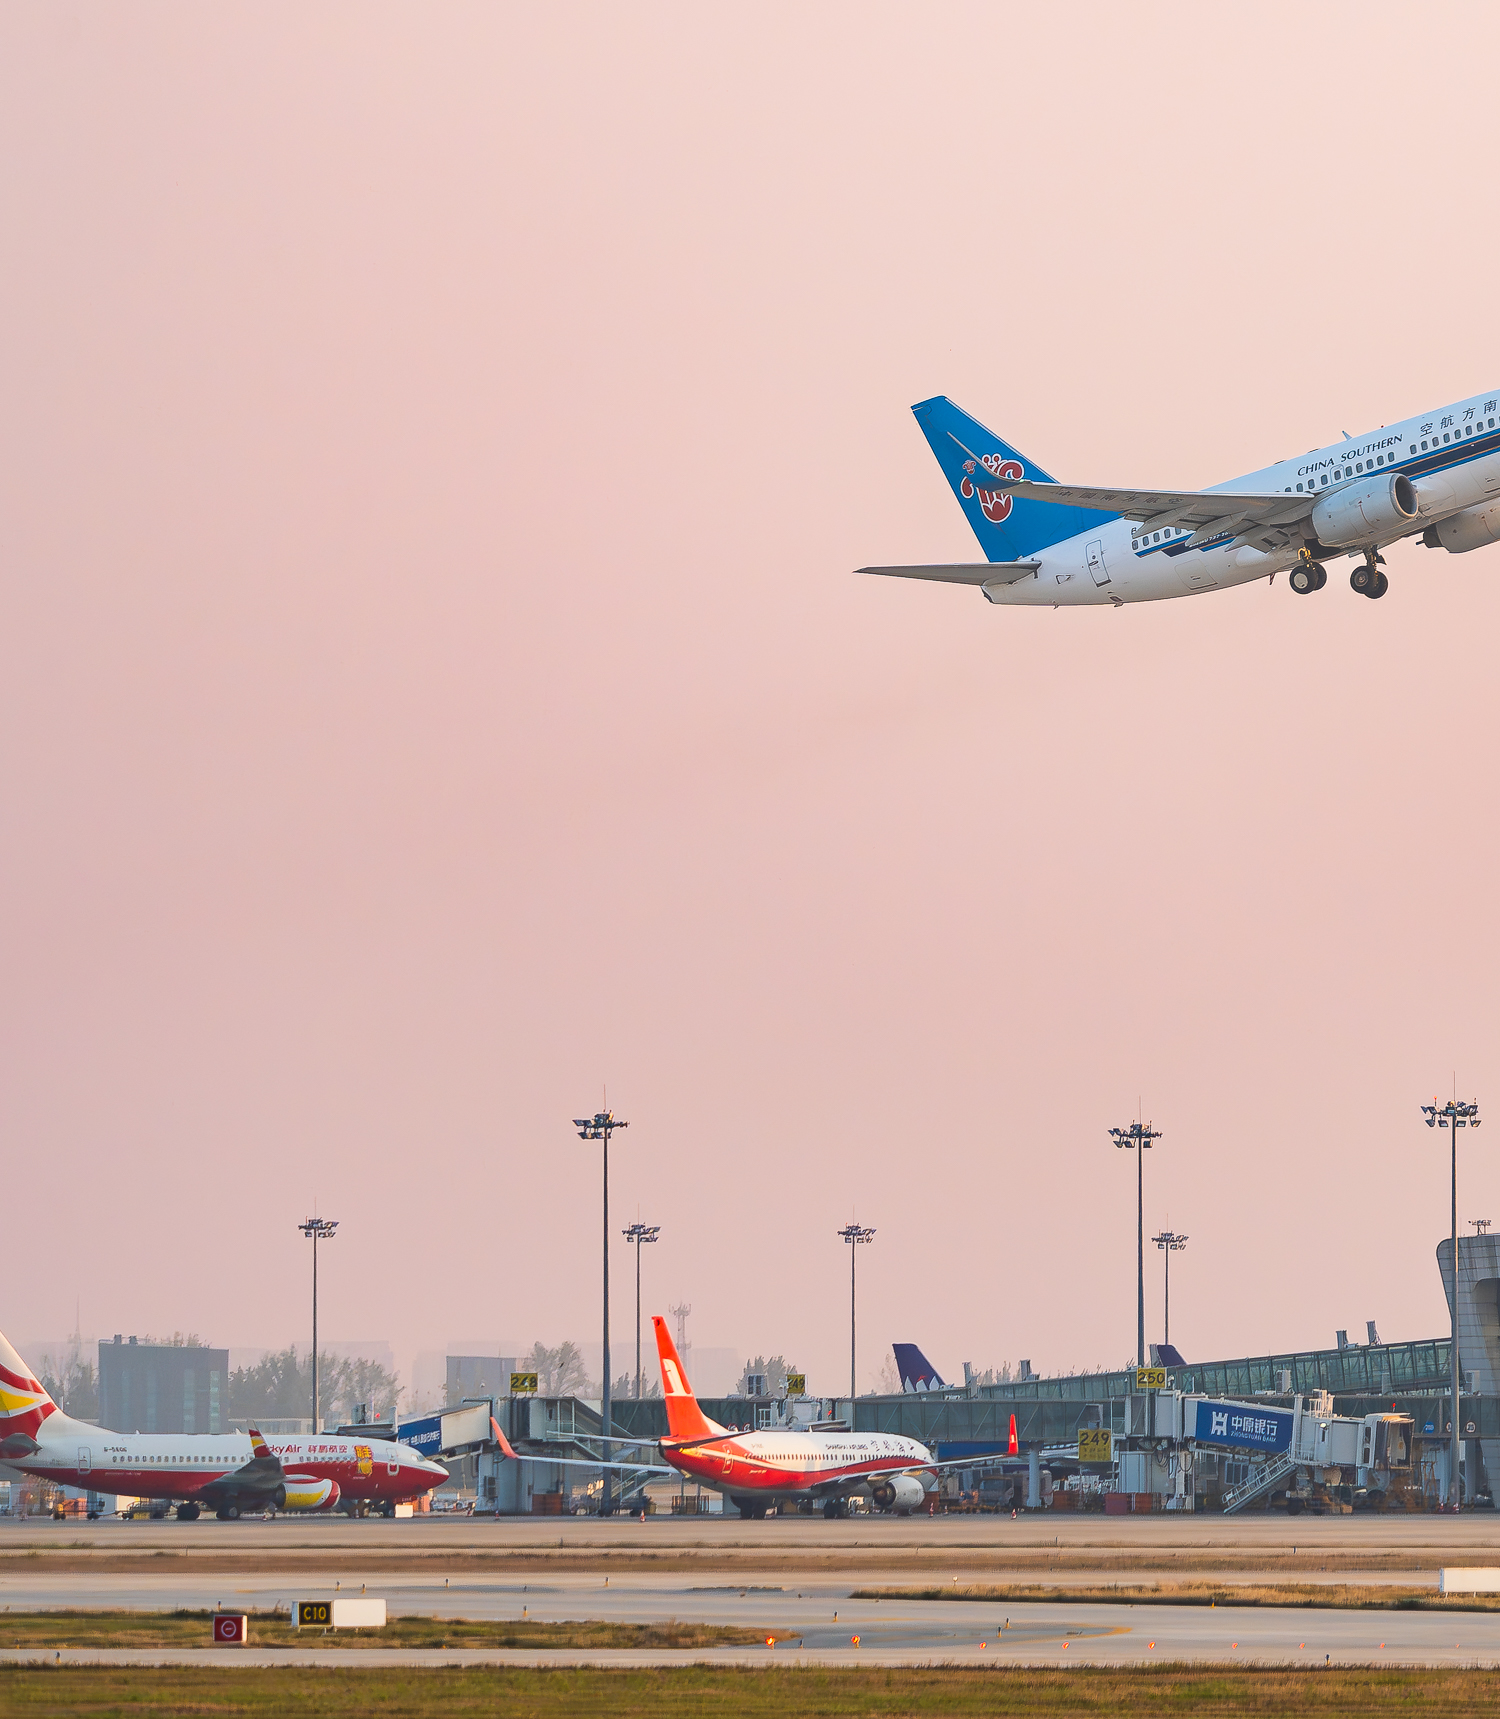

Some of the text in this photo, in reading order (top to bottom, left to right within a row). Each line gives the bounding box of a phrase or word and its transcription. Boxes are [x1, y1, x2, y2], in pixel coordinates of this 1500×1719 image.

[1297, 433, 1403, 477] CHINA SOUTHERN
[1138, 1372, 1165, 1384] 250
[1231, 1415, 1278, 1437] 中原银行
[1080, 1432, 1110, 1446] 249
[303, 1606, 327, 1621] C10
